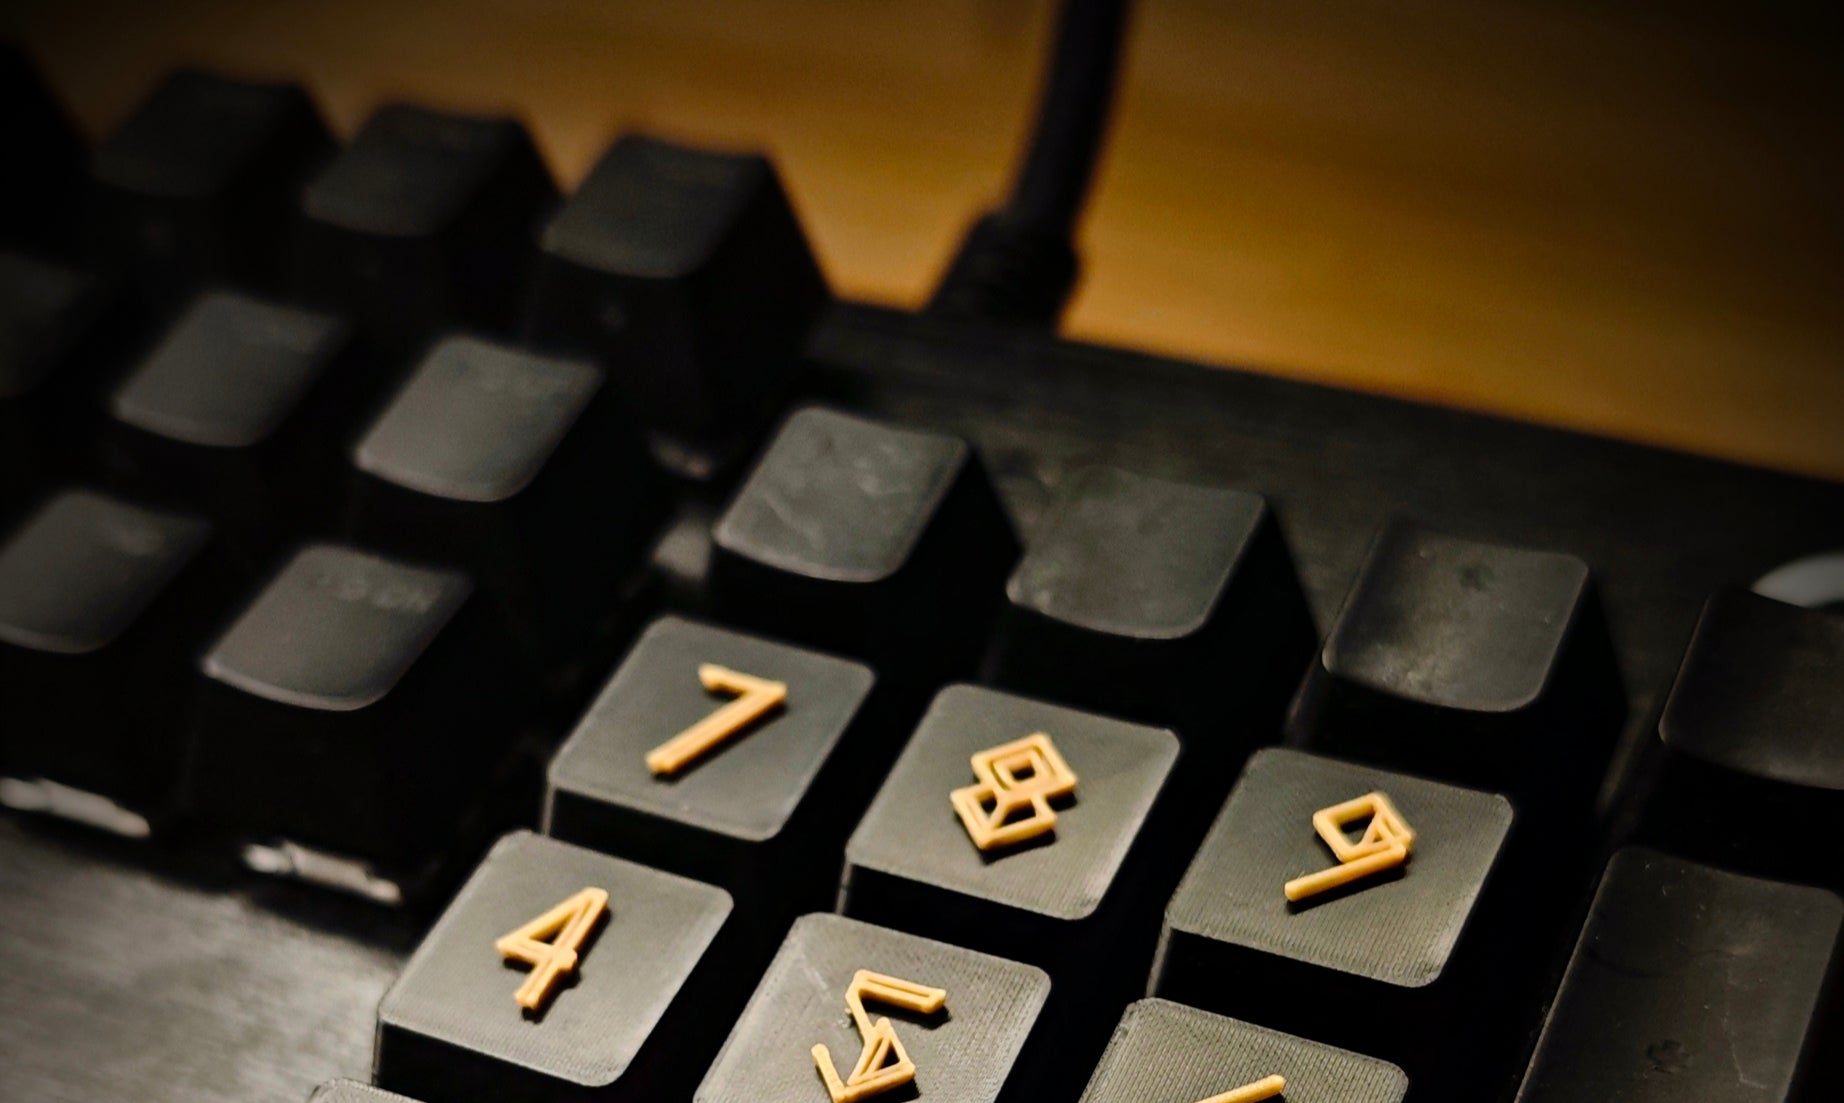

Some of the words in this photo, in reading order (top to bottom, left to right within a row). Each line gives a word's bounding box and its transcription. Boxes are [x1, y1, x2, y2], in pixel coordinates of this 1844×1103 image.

[647, 664, 788, 775] 7
[949, 731, 1080, 850] 8
[1283, 790, 1416, 905] 9
[496, 886, 609, 1012] 4
